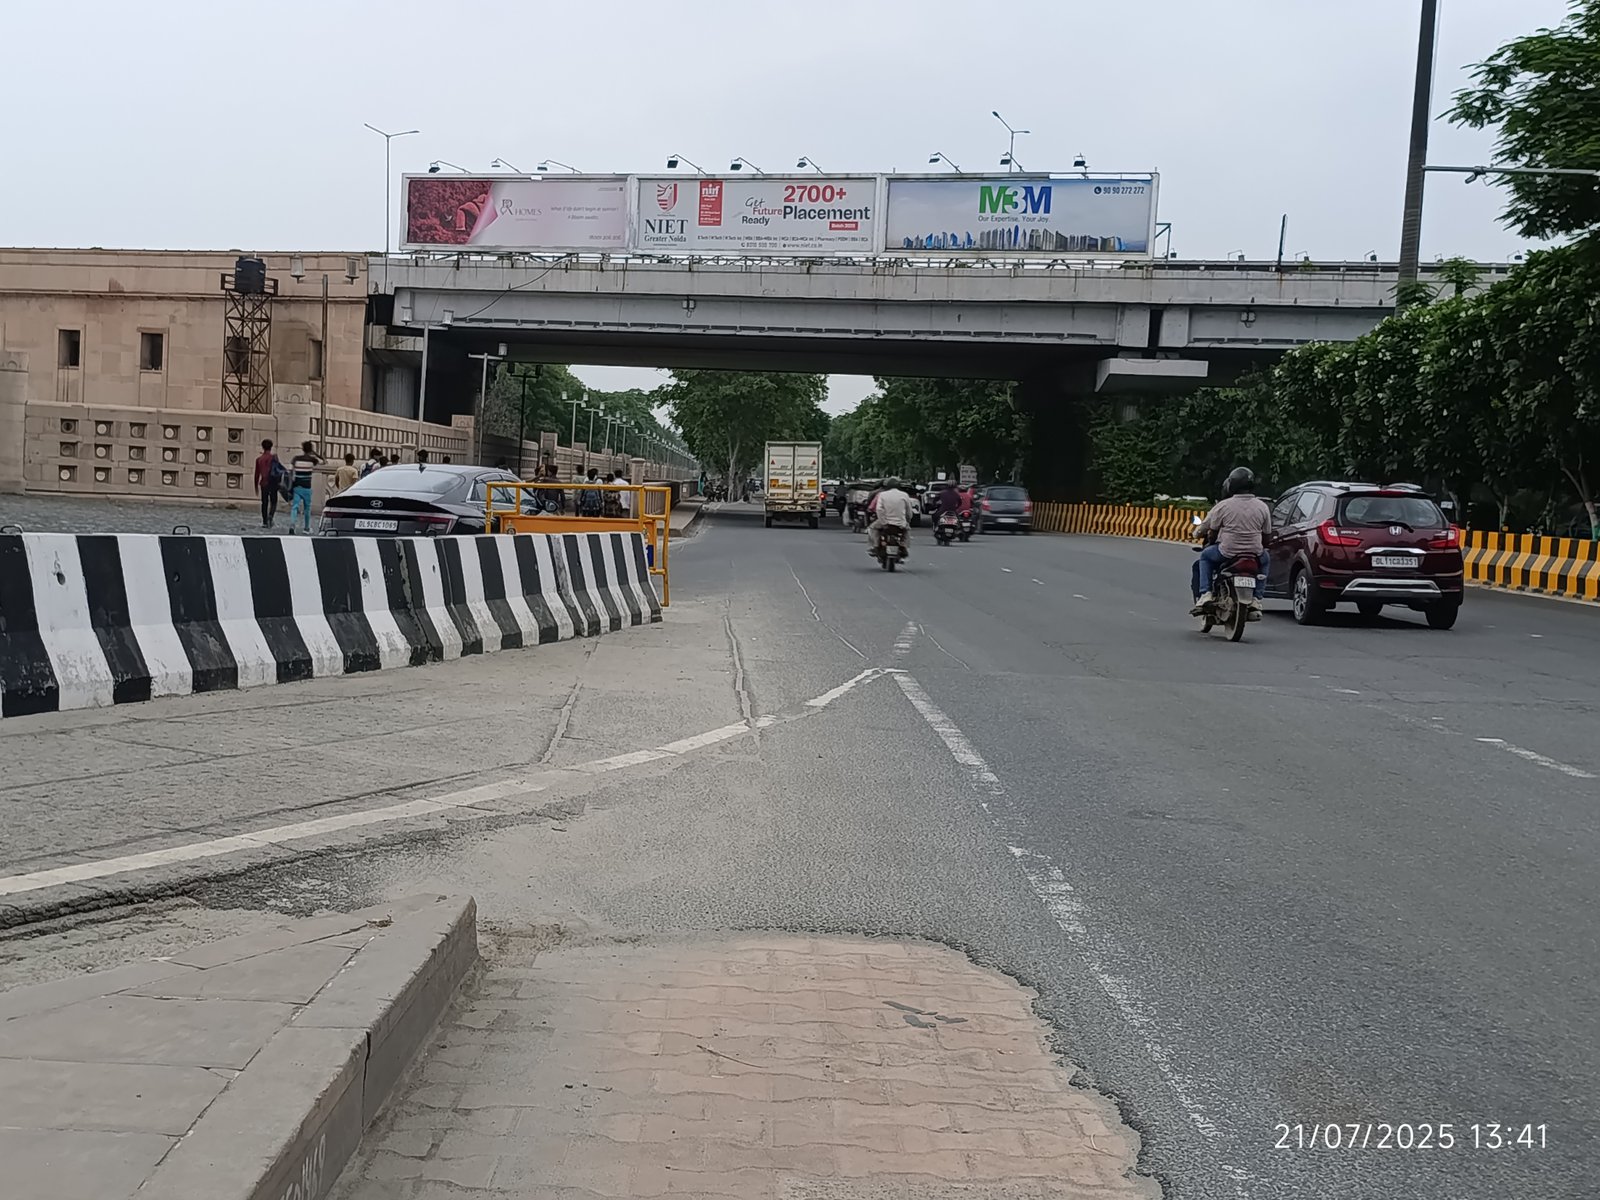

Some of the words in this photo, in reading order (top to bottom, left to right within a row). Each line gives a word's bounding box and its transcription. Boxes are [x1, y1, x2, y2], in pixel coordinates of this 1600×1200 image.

[702, 183, 720, 195] nirf
[783, 185, 847, 203] 2700+
[1121, 186, 1133, 195] 272
[1133, 186, 1145, 195] 272
[745, 197, 766, 208] Get
[978, 186, 1052, 214] M3M
[752, 207, 783, 216] Future
[783, 206, 871, 220] Placement
[644, 219, 688, 234] NIET
[741, 216, 770, 226] Ready
